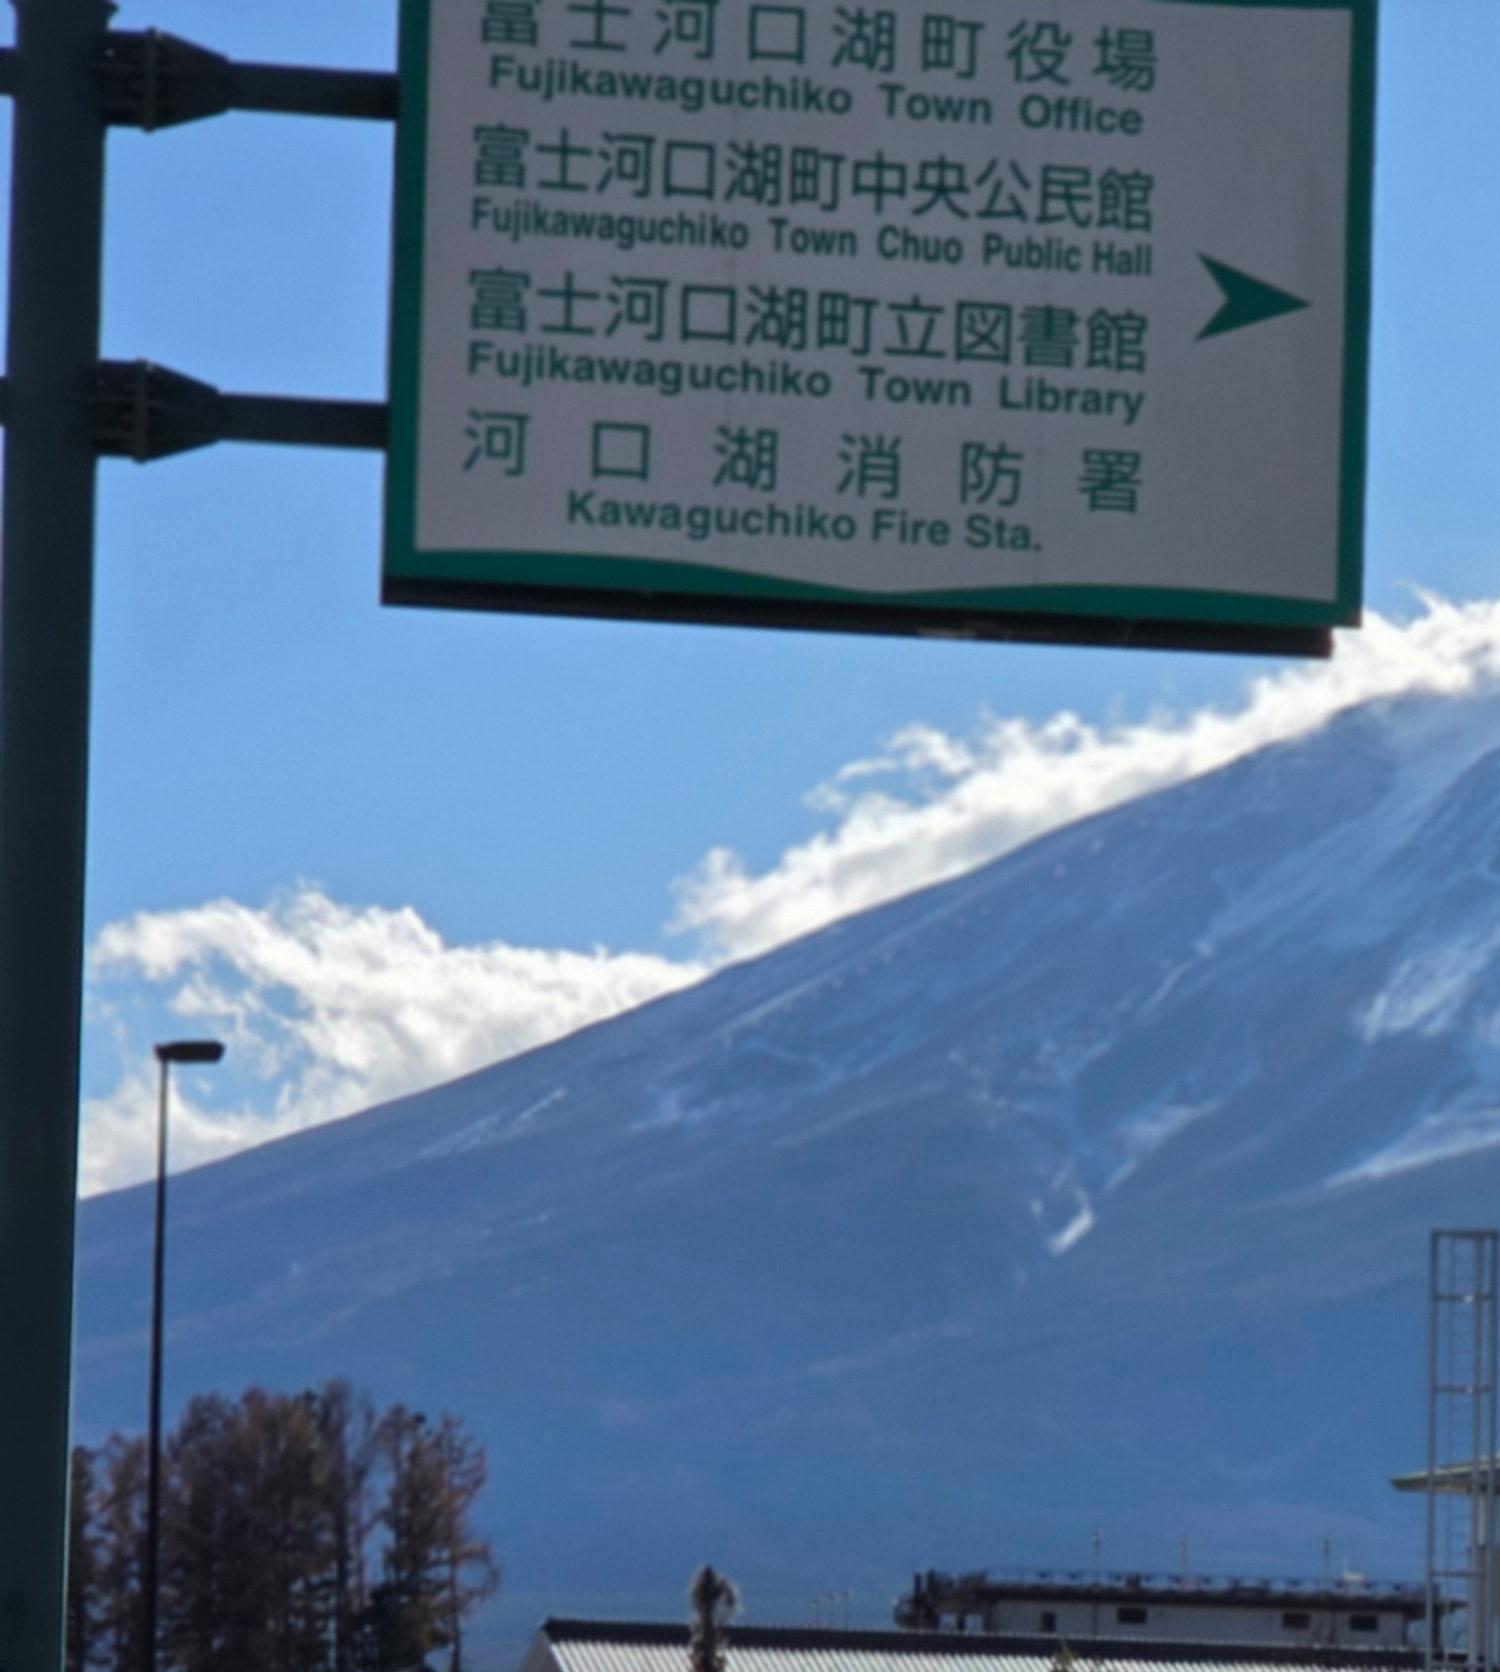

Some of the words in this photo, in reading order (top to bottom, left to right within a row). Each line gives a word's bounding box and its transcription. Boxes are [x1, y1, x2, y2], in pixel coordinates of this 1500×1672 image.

[489, 55, 853, 115] Fujikawaguchiko
[879, 83, 993, 125] Town
[1019, 94, 1144, 136] Office
[473, 122, 1156, 233] 富士河口湖町中央公民館
[471, 198, 749, 251] Fujikawaguchiko
[769, 217, 857, 257] Town
[877, 225, 964, 265] Chuo
[983, 231, 1082, 273] Public
[1093, 241, 1153, 277] Hall
[467, 267, 1149, 374] 富士河口湖町立図書館
[467, 341, 832, 398] Fujikawaguchiko
[858, 366, 973, 408] Town
[999, 375, 1145, 426] Library
[462, 408, 1144, 513] 河口湖消防署
[566, 490, 857, 542] Kawaguchiko
[871, 508, 951, 546] Fire
[964, 514, 1043, 551] Sta.
